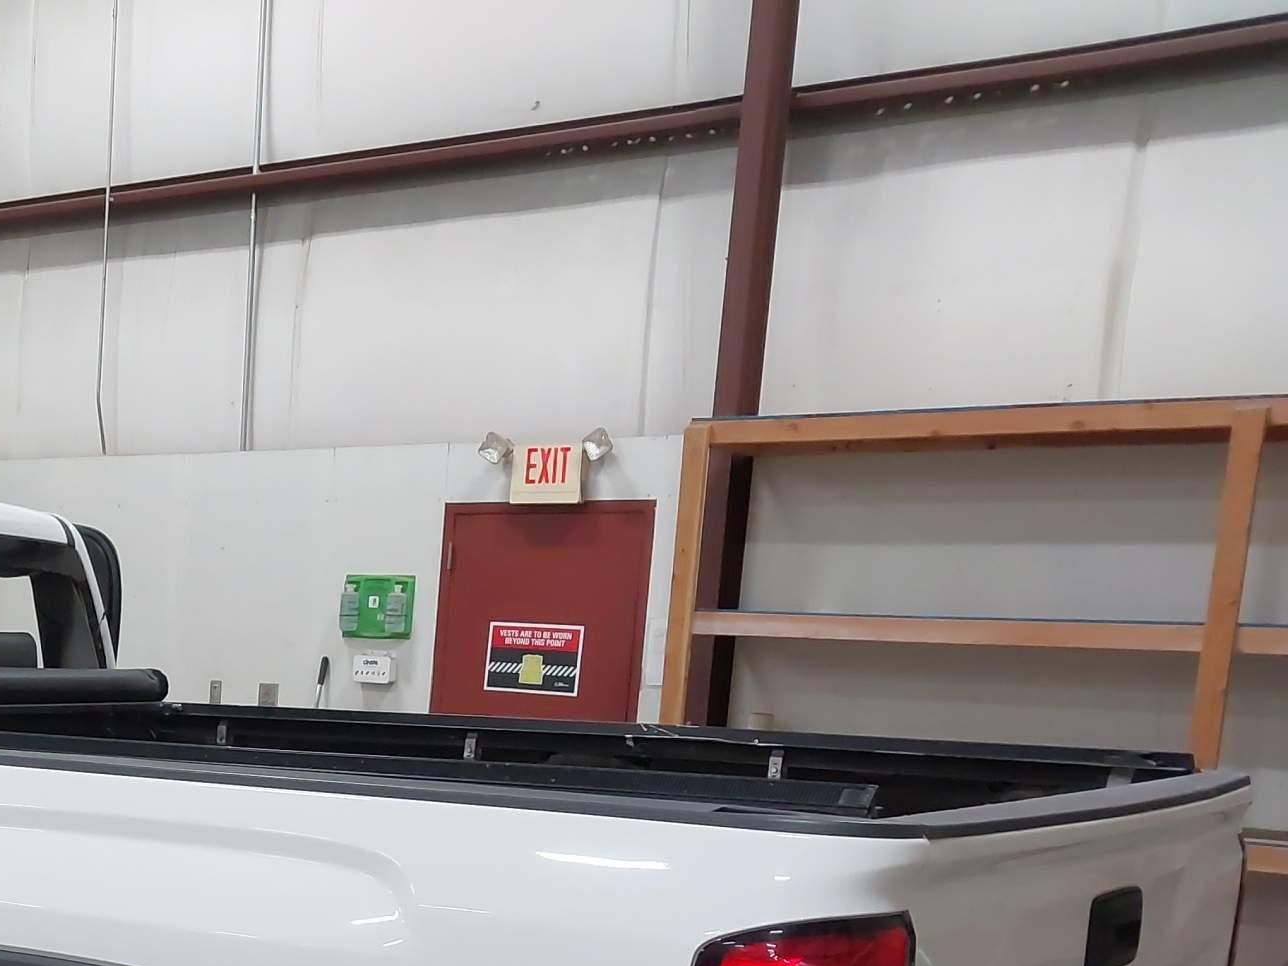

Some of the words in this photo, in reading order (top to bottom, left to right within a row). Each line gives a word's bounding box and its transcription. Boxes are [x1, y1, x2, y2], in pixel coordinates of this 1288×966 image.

[525, 447, 571, 484] EXIT
[499, 629, 519, 637] VESTS
[520, 630, 532, 638] ARE
[534, 630, 542, 638] TO
[543, 631, 551, 639] BE
[552, 632, 573, 641] WORN
[504, 637, 530, 645] BEYOND
[531, 638, 546, 646] THIS
[546, 639, 566, 648] POINT
